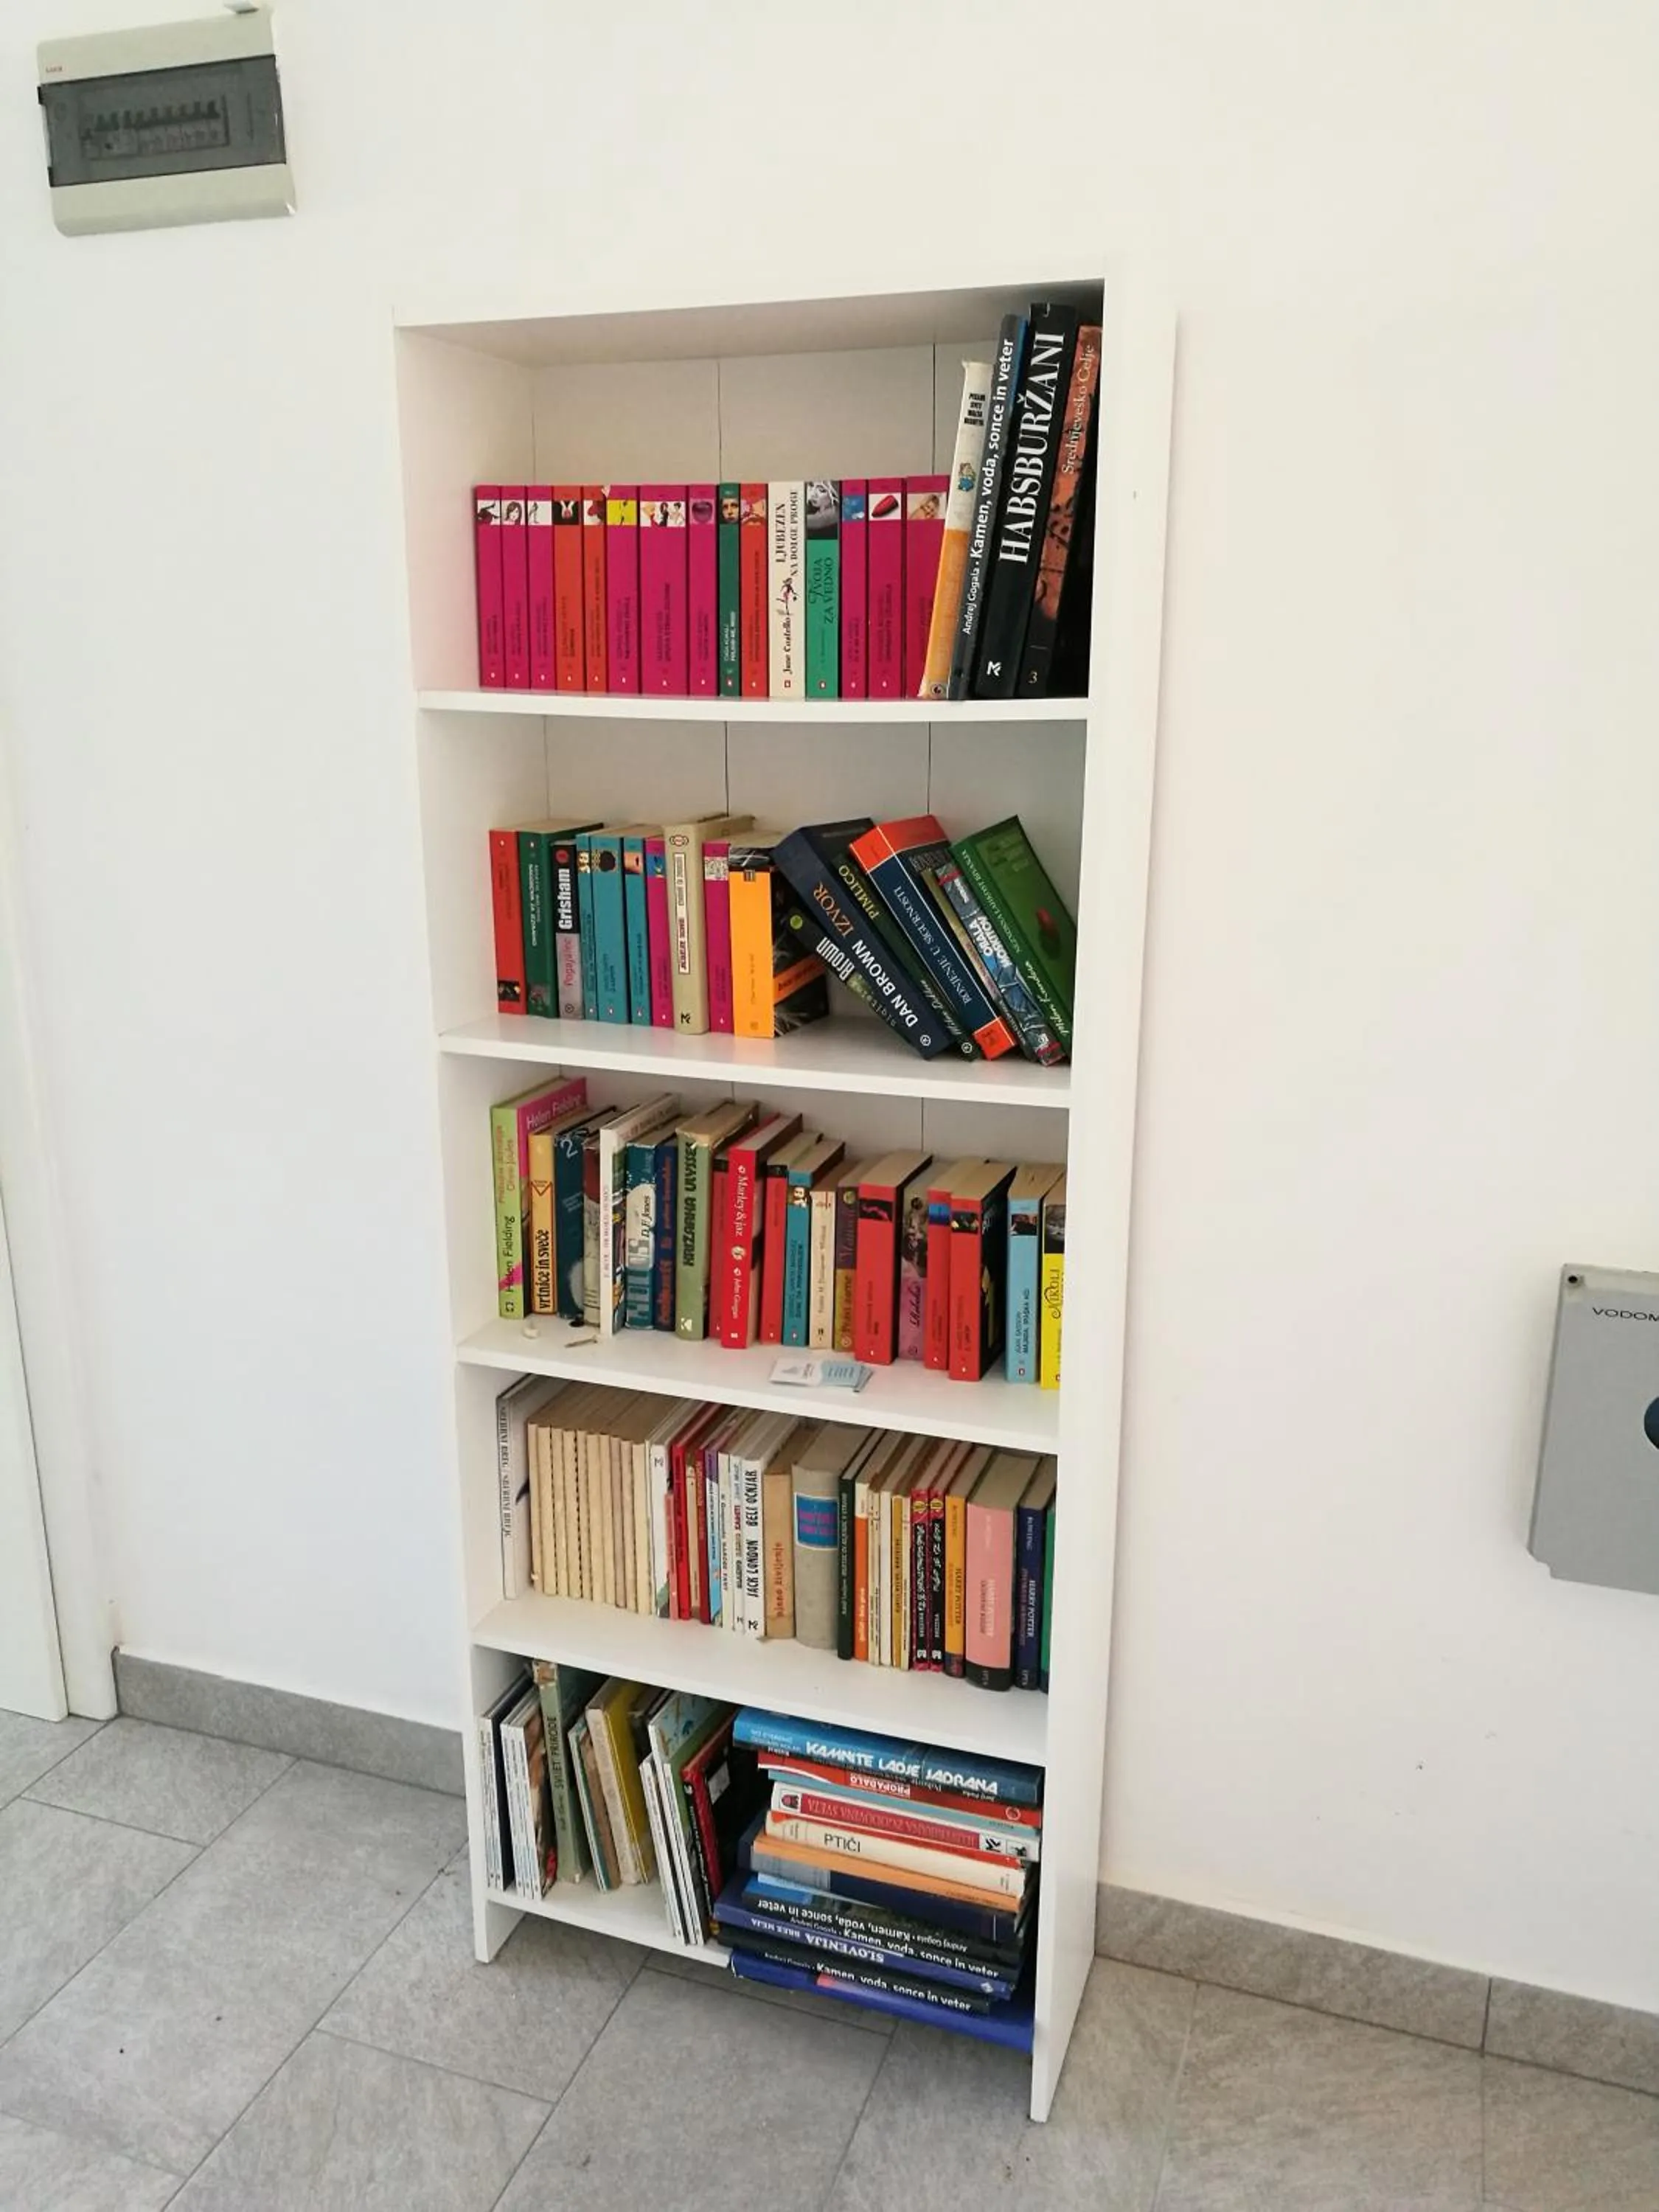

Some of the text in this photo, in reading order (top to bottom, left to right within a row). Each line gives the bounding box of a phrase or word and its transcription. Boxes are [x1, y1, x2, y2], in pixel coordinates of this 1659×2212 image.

[995, 338, 1013, 380] veter
[992, 383, 1006, 403] in
[989, 406, 1004, 449] sonce
[999, 332, 1064, 563] HABSBURŽANI
[979, 452, 999, 494] voda,
[776, 503, 786, 563] LJUBEZEN
[970, 498, 993, 559] Kamen,
[824, 557, 834, 625] ZA VEDNO
[557, 868, 573, 931] Grisham
[813, 880, 854, 939] IZVOR
[838, 865, 880, 919] PIMLICO
[894, 886, 972, 1005] RONJENJE U SIGURNOSTI
[966, 919, 993, 956] OBALA
[815, 936, 855, 981] Brown
[852, 940, 918, 1027] DAN BROWN
[501, 1216, 516, 1257] Fielding
[681, 1197, 695, 1267] KRIŽARKA
[505, 1259, 515, 1293] Helen
[540, 1258, 549, 1270] in
[538, 1271, 551, 1310] vrtnice
[746, 1539, 759, 1573] LONDON
[745, 1576, 759, 1598] JACK
[806, 1741, 873, 1768] KAMNITE
[878, 1759, 919, 1778] LADJE
[926, 1767, 998, 1795] JADRANA
[824, 1831, 861, 1853] PTIČI
[758, 1899, 786, 1916] veter
[788, 1905, 799, 1918] in
[801, 1907, 832, 1922] sonce
[835, 1914, 865, 1932] voda,
[805, 1932, 884, 1963] SLOVENIJA
[955, 1956, 965, 1971] in
[967, 1961, 999, 1978] veter
[928, 1988, 938, 2003] in
[940, 1993, 972, 2011] veter
